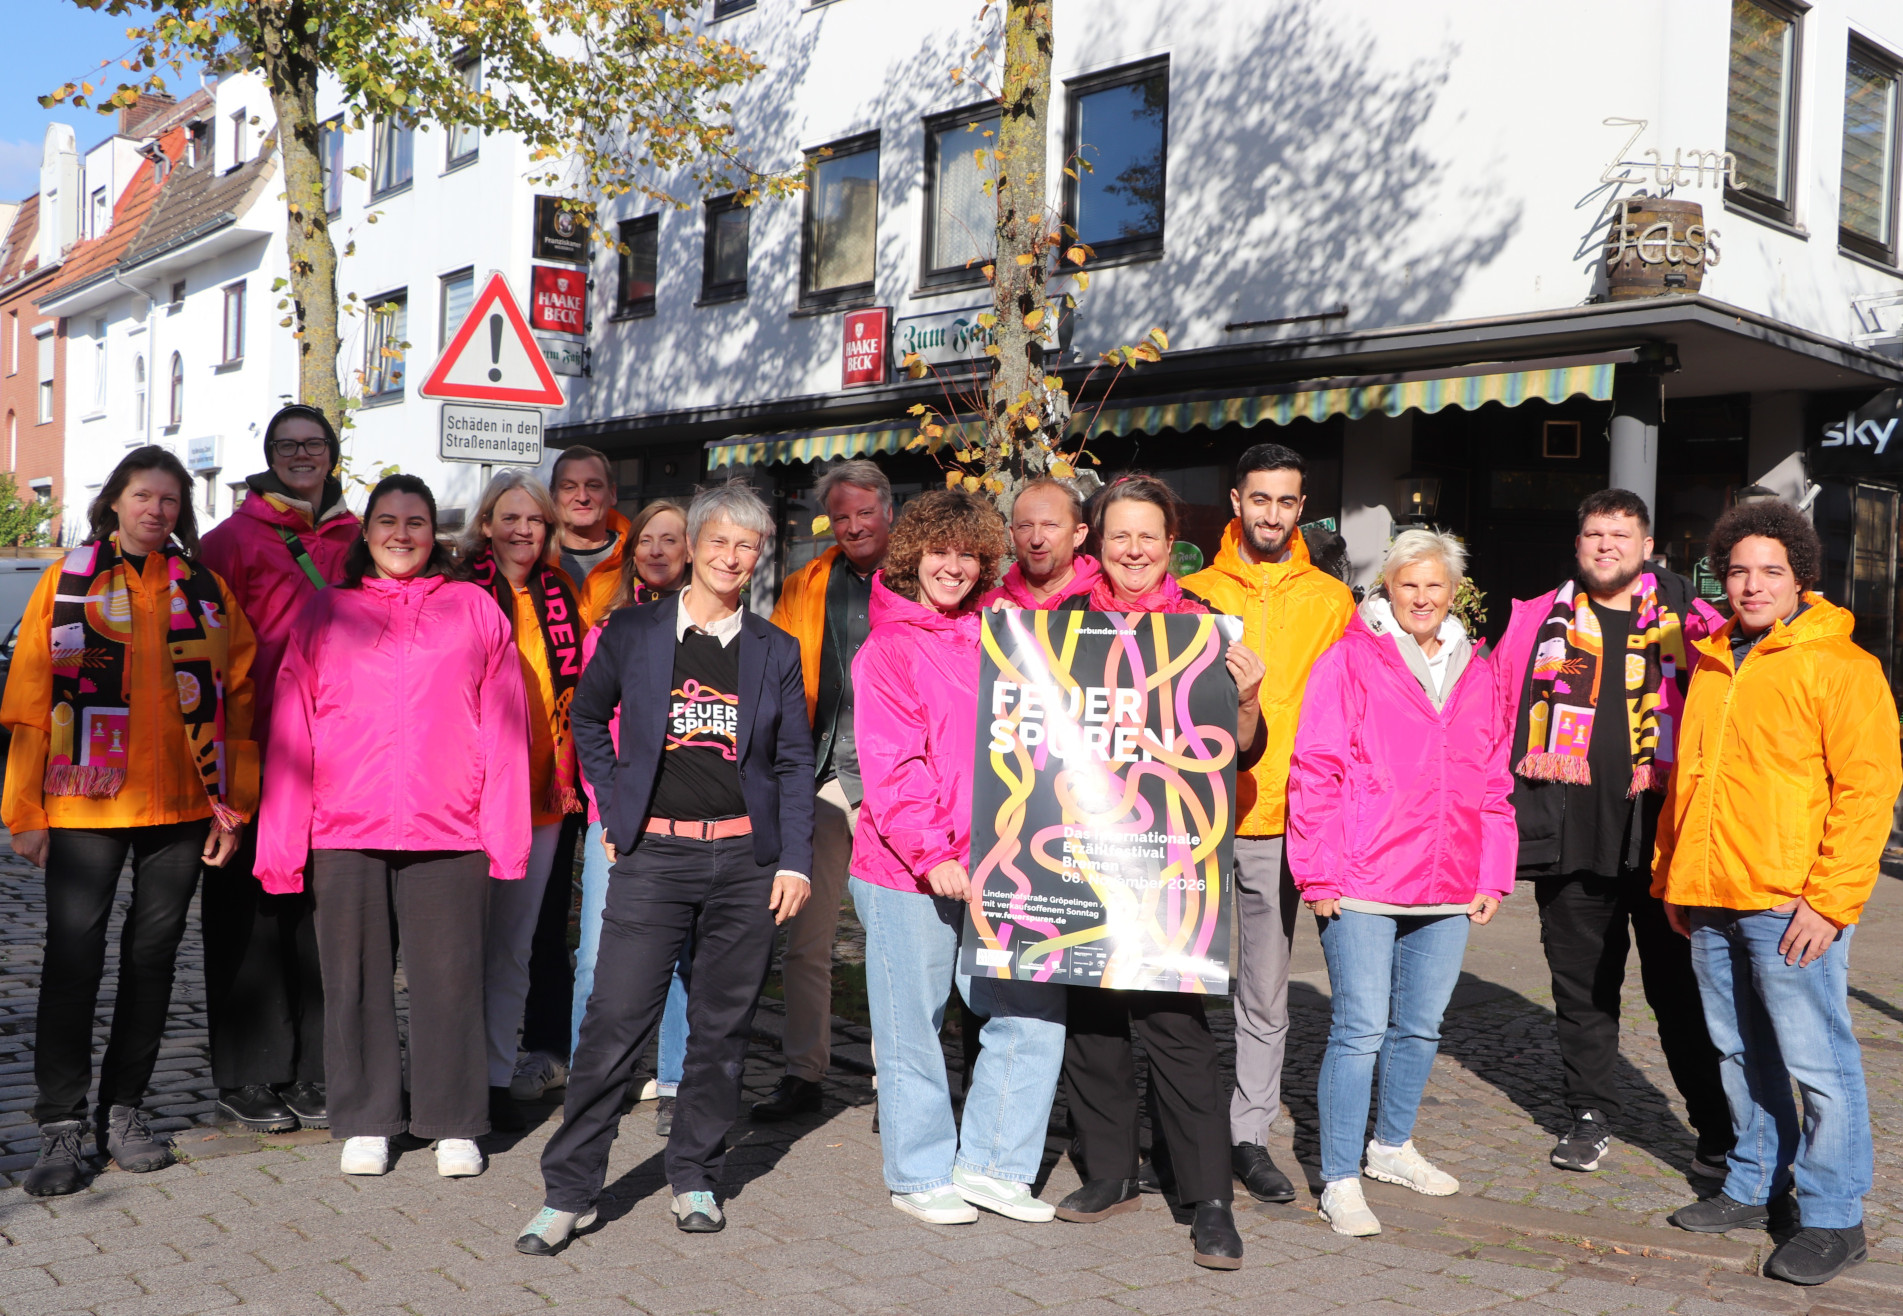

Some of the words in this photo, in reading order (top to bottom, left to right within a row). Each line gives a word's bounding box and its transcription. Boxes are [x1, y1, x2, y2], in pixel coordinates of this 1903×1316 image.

[1600, 117, 1748, 190] Zum
[538, 291, 582, 311] HAAKE
[544, 306, 577, 325] BECK
[845, 338, 879, 357] HAAKE
[901, 325, 946, 357] Zum
[847, 354, 873, 372] BECK
[447, 415, 498, 432] Schäden
[502, 419, 512, 433] in
[517, 420, 538, 435] den
[1821, 410, 1899, 455] sky
[446, 433, 539, 455] Straßenanlagen
[1073, 626, 1118, 635] verbunden
[1119, 628, 1137, 636] sein
[672, 702, 738, 721] FEUER
[991, 680, 1143, 724] FEUER
[1063, 826, 1091, 840] Das
[1062, 841, 1165, 859] Erzählfestival
[1062, 856, 1119, 871] Bremen
[1061, 871, 1084, 884] 08.
[1088, 873, 1164, 890] November
[1167, 878, 1206, 892] 2026
[982, 889, 1048, 903] Lindenhofstraße
[1049, 896, 1098, 908] Gröpelingen
[980, 910, 1067, 925] www.feuerspuren.de
[981, 899, 995, 908] mit
[997, 901, 1065, 915] verkaufsoffenem
[1066, 907, 1099, 919] Sonntag
